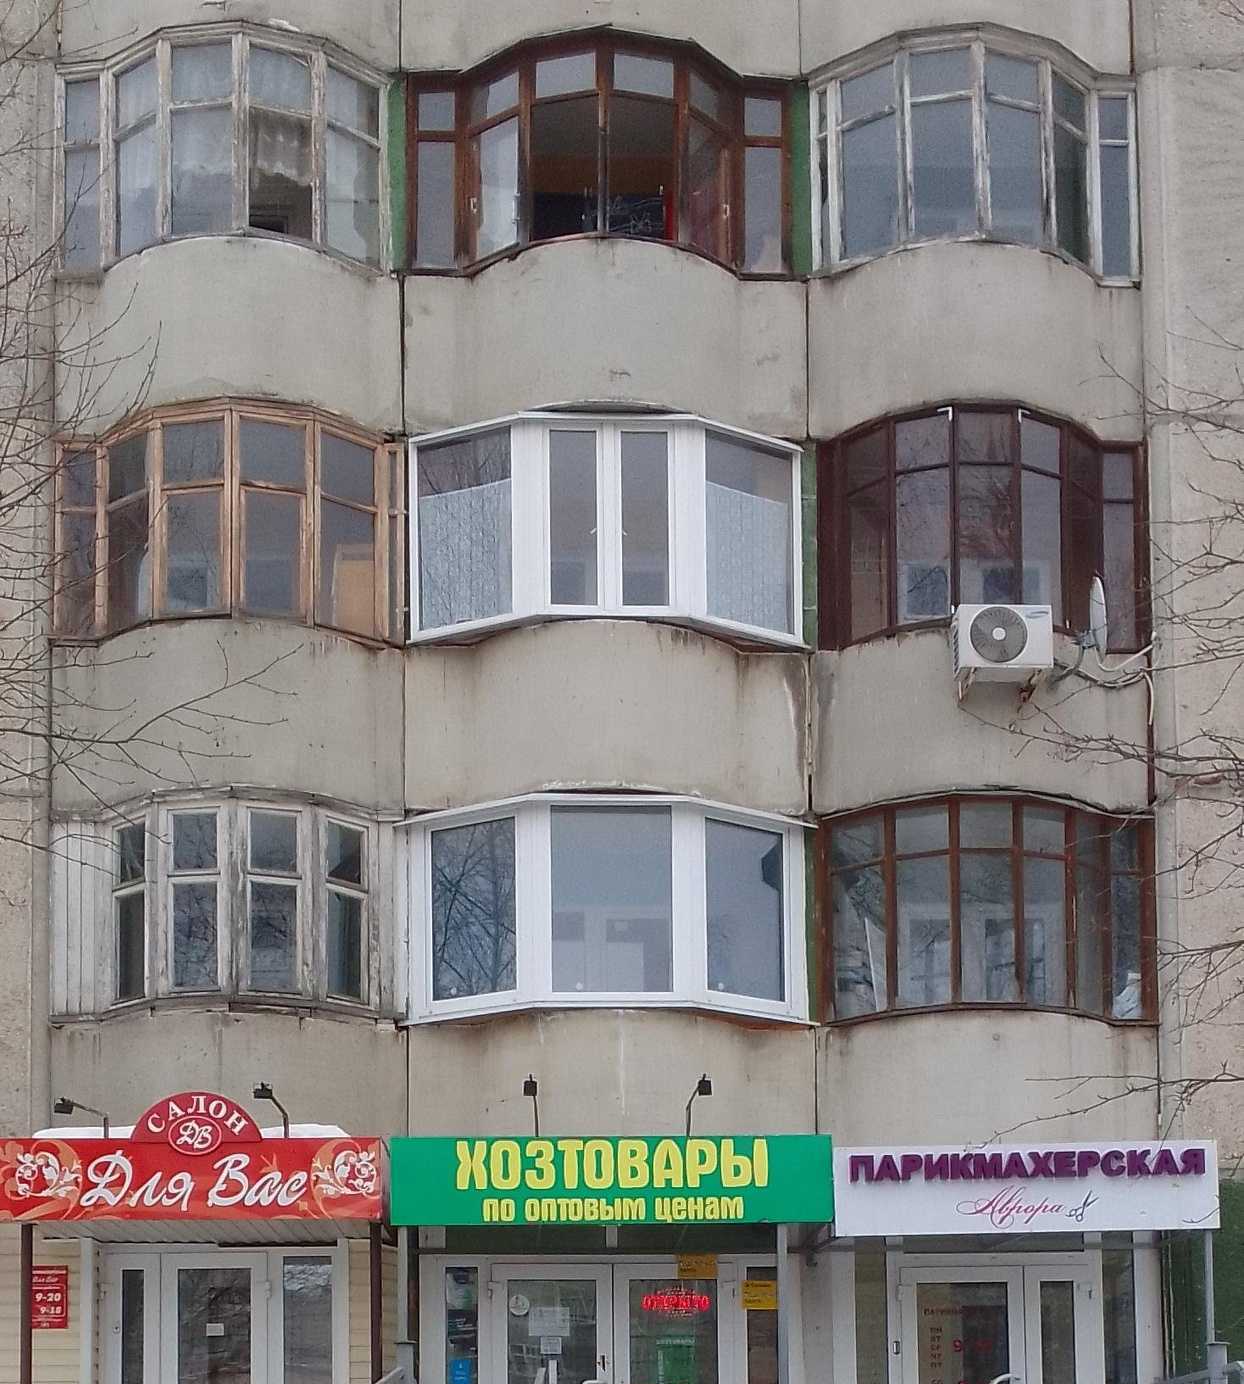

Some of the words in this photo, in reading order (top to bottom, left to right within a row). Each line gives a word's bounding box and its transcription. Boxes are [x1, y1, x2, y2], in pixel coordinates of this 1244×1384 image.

[147, 1095, 249, 1136] САЛОН
[80, 1149, 196, 1212] Для
[207, 1153, 309, 1208] Вас
[455, 1138, 769, 1190] ХОЗТОВАРЫ
[848, 1147, 1206, 1185] ПАРИКМАХЕРСКАЯ
[655, 1195, 744, 1224] ценам
[955, 1184, 1066, 1230] Аврора
[35, 1292, 62, 1302] 9-20
